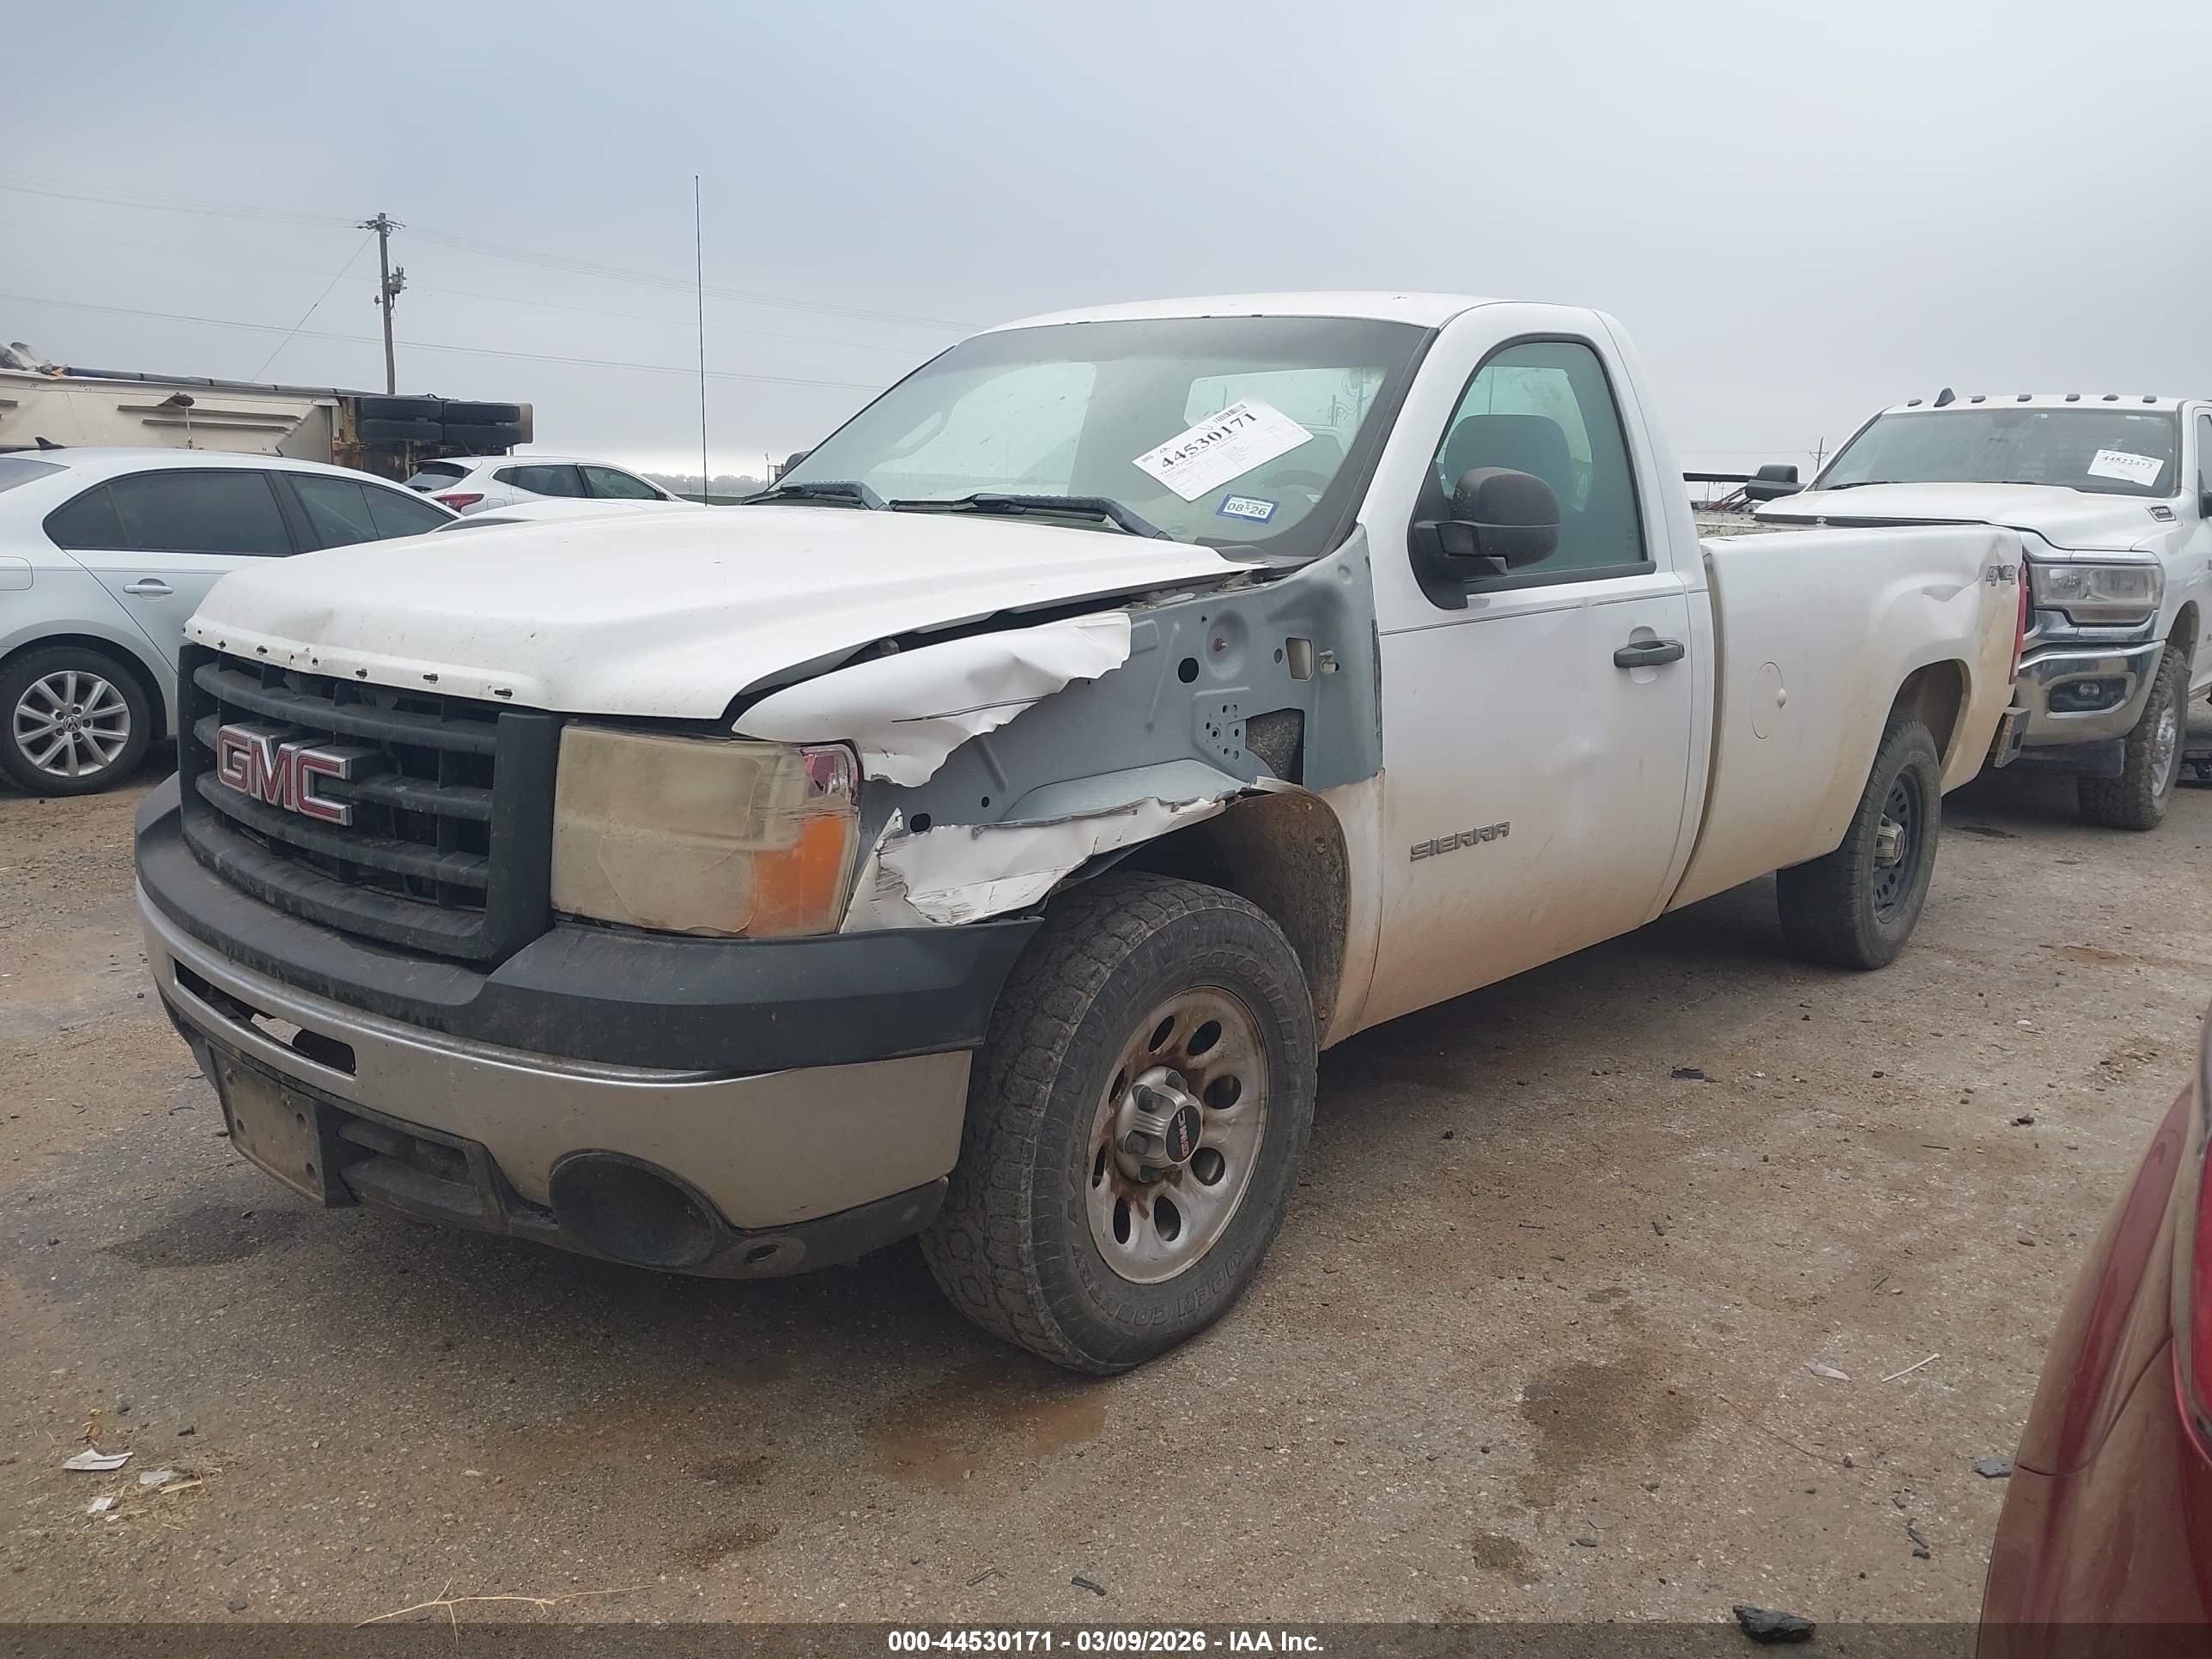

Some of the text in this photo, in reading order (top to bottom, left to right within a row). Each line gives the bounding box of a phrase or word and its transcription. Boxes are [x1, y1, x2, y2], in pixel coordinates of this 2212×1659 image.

[1162, 413, 1257, 468] 44530171
[1228, 502, 1244, 512] 08
[1250, 507, 1268, 517] 26
[217, 725, 352, 826] GMC
[1410, 820, 1510, 861] SIERRA
